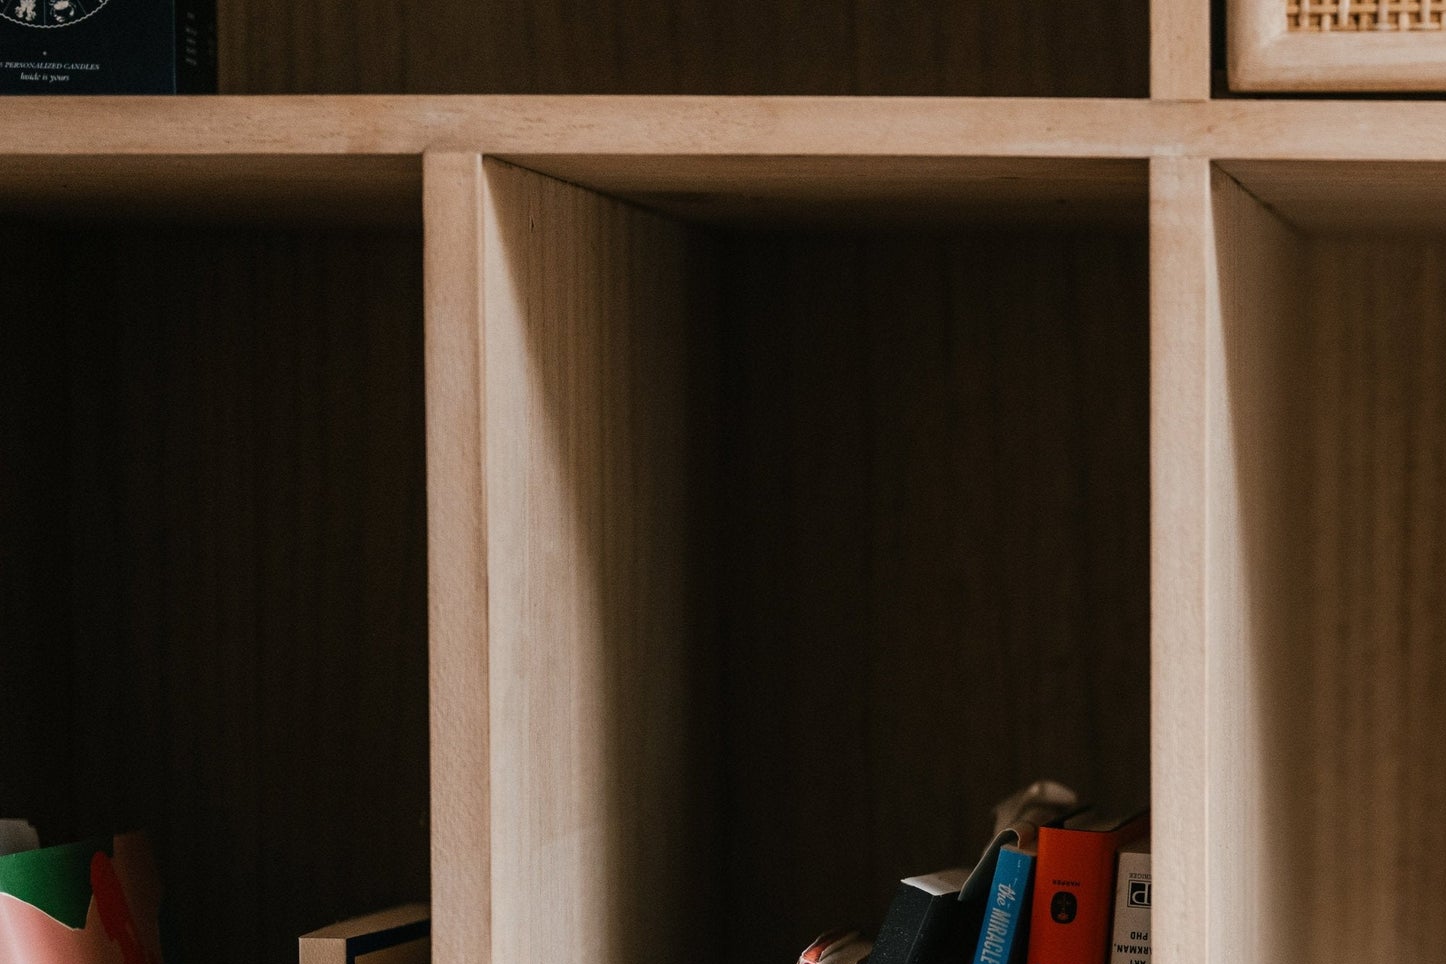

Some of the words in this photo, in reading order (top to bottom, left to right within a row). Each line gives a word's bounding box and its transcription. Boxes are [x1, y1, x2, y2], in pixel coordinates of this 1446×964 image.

[4, 61, 62, 70] PERSONALIZED
[63, 63, 100, 71] CANDLES
[49, 74, 70, 83] yours
[996, 881, 1016, 906] the
[1130, 931, 1148, 941] PHD
[1114, 944, 1152, 955] RKMAN,
